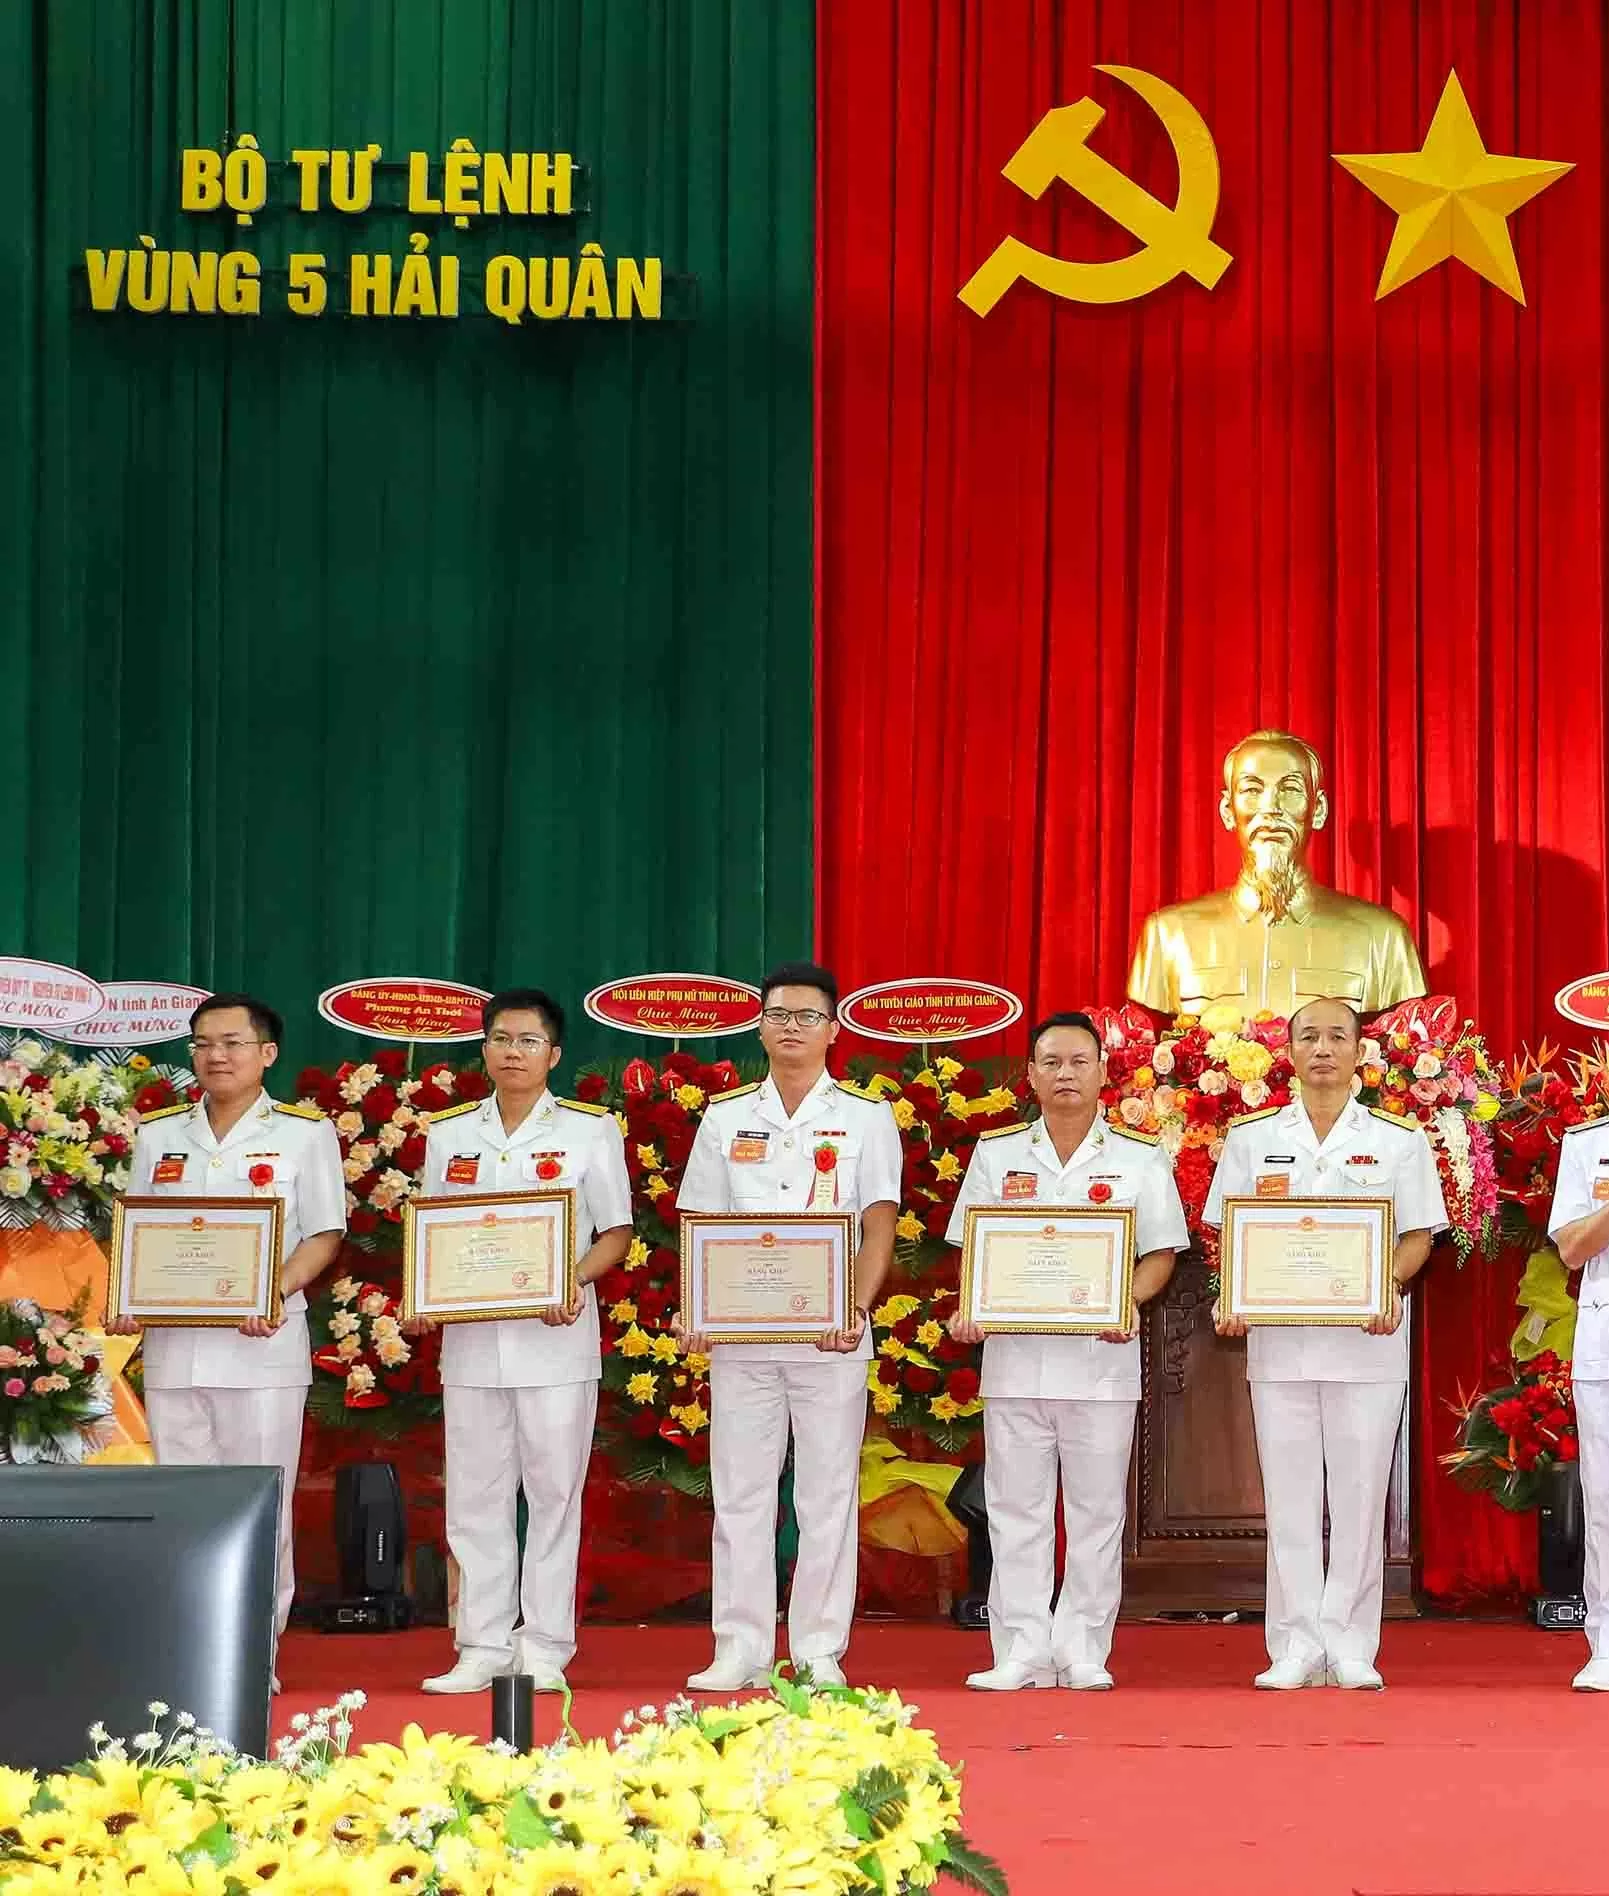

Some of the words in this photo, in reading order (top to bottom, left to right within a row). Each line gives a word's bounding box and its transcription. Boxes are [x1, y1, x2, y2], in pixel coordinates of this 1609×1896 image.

[181, 134, 266, 226] BỘ
[292, 144, 381, 213] TƯ
[408, 139, 571, 228] LỆNH
[86, 235, 261, 314] VÙNG
[288, 254, 327, 313] 5
[350, 233, 459, 316] HẢI
[486, 243, 662, 327] QUÂN
[152, 997, 167, 1009] An
